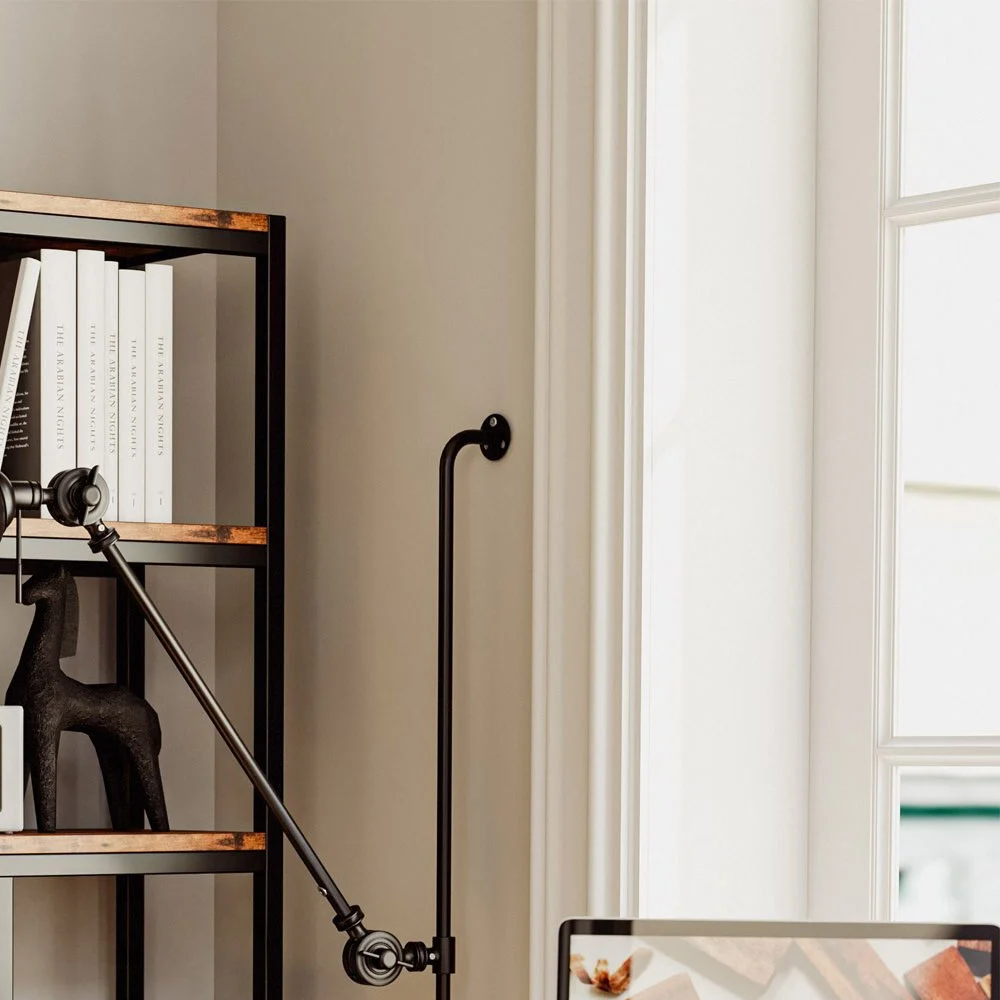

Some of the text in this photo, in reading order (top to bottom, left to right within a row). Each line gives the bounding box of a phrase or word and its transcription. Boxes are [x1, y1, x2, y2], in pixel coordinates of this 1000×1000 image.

[56, 325, 65, 450] THE ARABIAN NIGHTS
[89, 325, 97, 451] THE ARABIAN NIGHTS
[108, 334, 116, 453] THE ARABIAN NIGHTS
